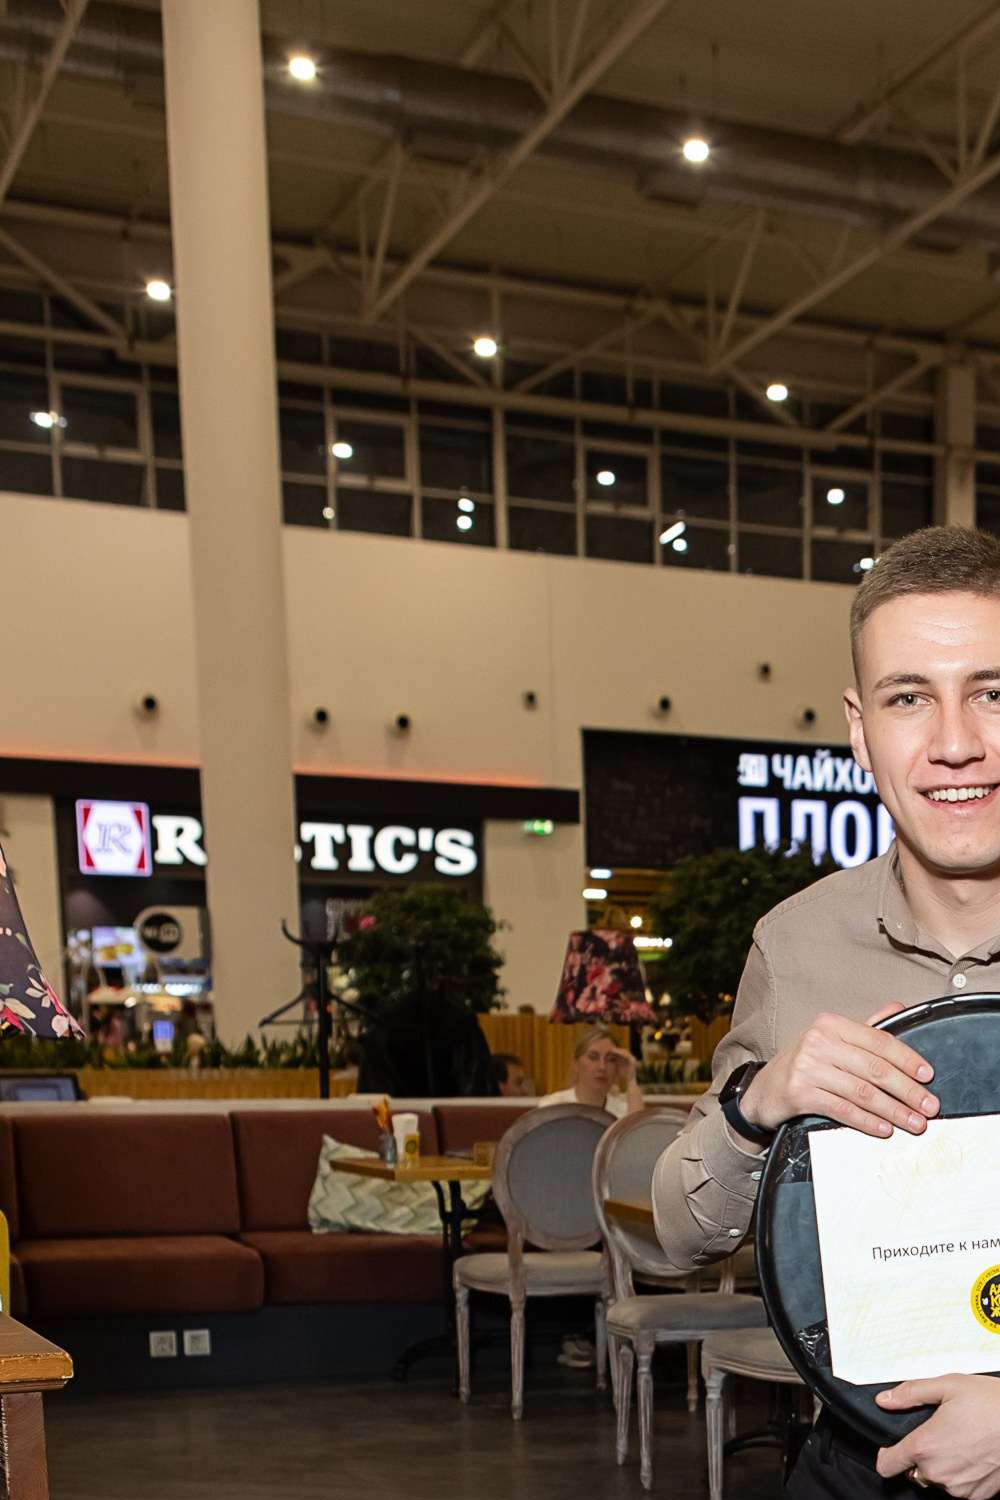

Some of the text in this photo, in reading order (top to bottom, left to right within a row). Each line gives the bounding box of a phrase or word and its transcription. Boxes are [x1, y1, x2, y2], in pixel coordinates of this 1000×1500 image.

[772, 749, 878, 795] ЧАЙХО
[872, 1242, 955, 1261] Приходите
[959, 1241, 968, 1251] к
